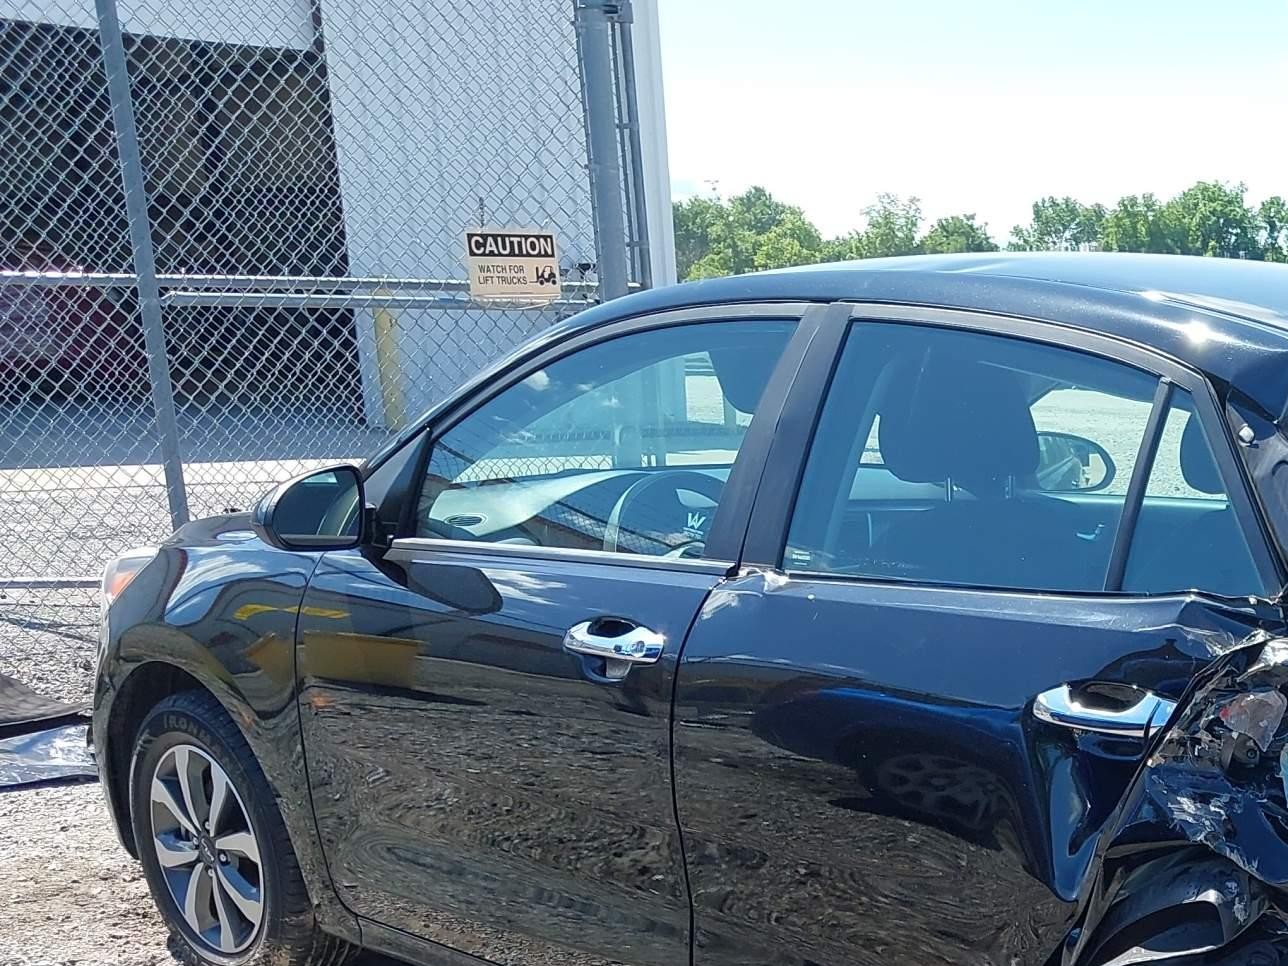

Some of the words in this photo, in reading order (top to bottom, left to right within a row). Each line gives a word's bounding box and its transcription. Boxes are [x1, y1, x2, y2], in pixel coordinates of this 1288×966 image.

[470, 236, 553, 256] CAUTION
[478, 264, 508, 274] WATCH
[508, 264, 525, 274] FOR
[478, 275, 495, 285] LIFT
[496, 275, 528, 285] TRUCKS
